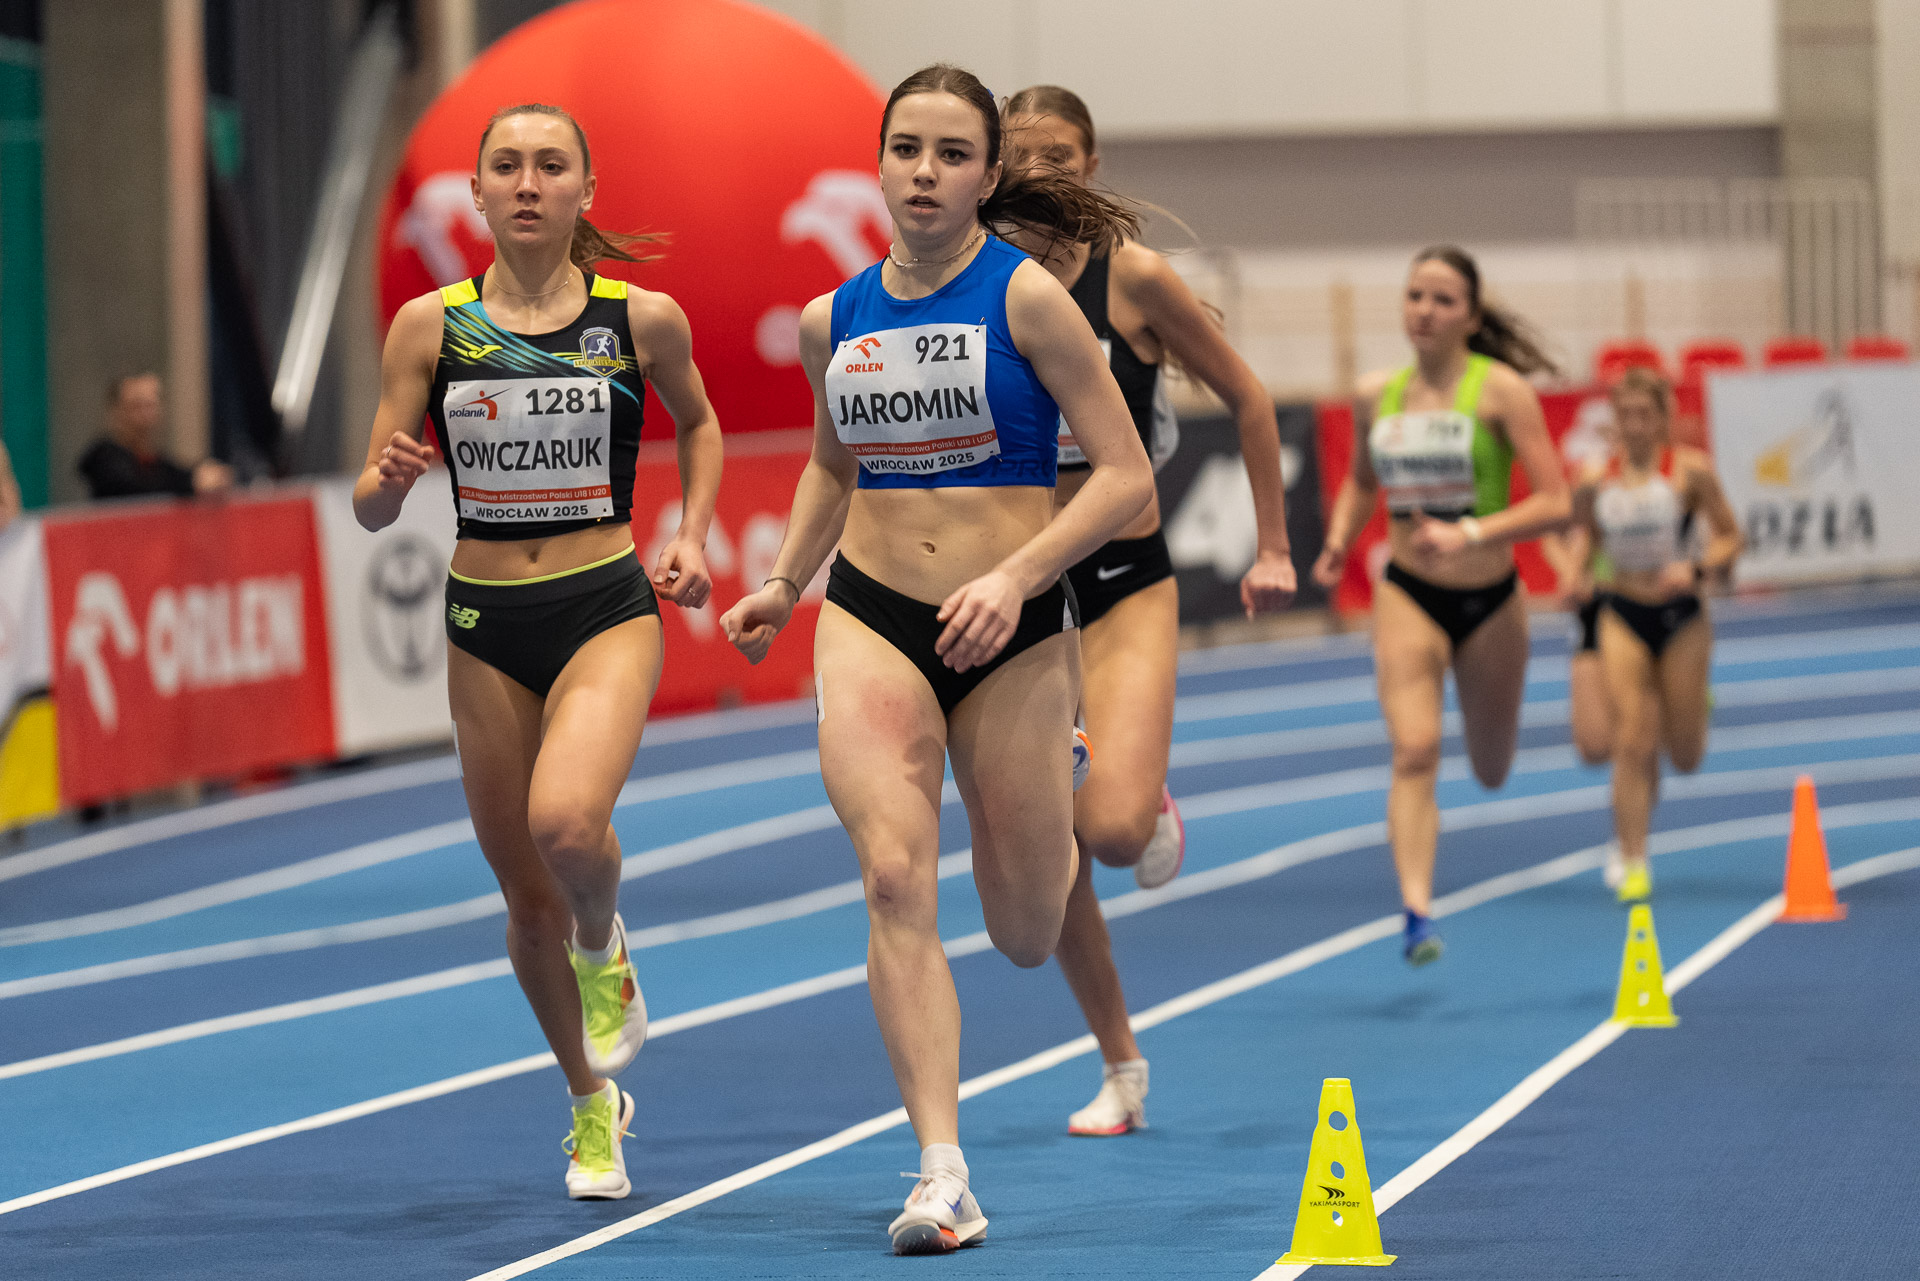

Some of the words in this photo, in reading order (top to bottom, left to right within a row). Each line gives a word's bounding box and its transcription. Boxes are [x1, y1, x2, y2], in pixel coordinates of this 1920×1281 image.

[915, 334, 970, 364] 921
[845, 362, 884, 374] ORLEN
[525, 387, 605, 416] 1281
[839, 386, 980, 426] JAROMIN
[449, 407, 486, 420] polanik
[861, 445, 888, 454] Halowe
[888, 443, 930, 453] Mistrzostwa
[931, 439, 956, 450] Polski
[957, 438, 971, 447] U18
[976, 433, 993, 443] U20
[456, 437, 603, 472] OWCZARUK
[866, 458, 935, 471] WROCŁAW
[938, 451, 975, 467] 2025
[475, 490, 498, 501] Halowe
[499, 492, 548, 501] Mistrzostwa
[549, 490, 573, 499] Polski
[574, 488, 588, 498] U18
[592, 487, 607, 497] U20
[475, 506, 550, 519] WROCŁAW
[553, 504, 589, 517] 2025
[148, 576, 305, 697] ORLEN
[1309, 1200, 1361, 1208] YAKIMASPORT
